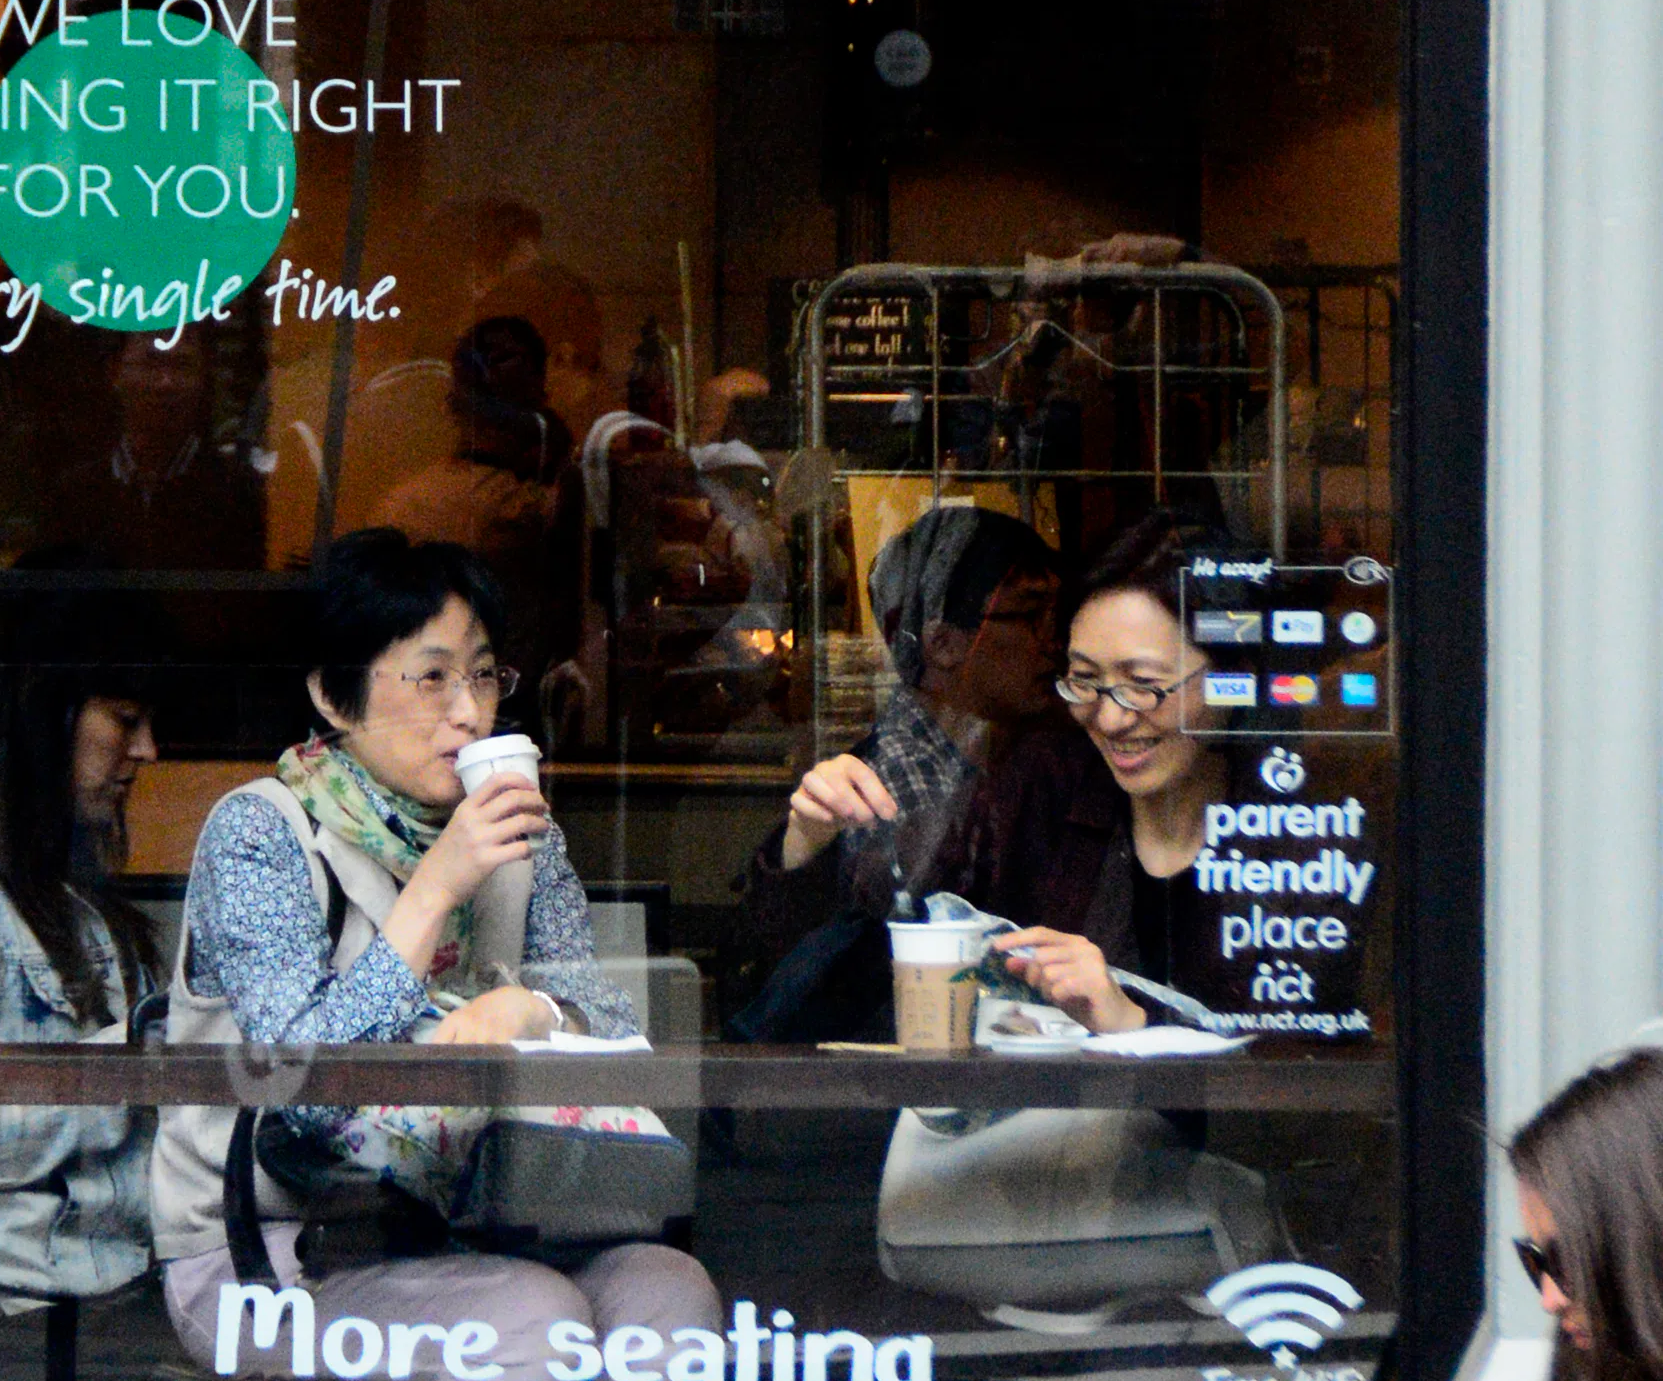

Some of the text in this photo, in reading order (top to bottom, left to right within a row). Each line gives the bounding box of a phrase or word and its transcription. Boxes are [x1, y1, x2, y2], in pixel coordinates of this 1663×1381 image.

[159, 80, 216, 132] IT
[247, 78, 462, 133] RIGHT
[134, 164, 300, 220] YOU.
[69, 258, 233, 352] single
[264, 258, 402, 326] time.
[1212, 682, 1249, 696] VISA
[1205, 796, 1366, 847] parent
[1193, 848, 1374, 905] friendly
[1221, 904, 1348, 960] place
[1198, 1009, 1370, 1036] www.nct.org.uk
[214, 1282, 505, 1378] More
